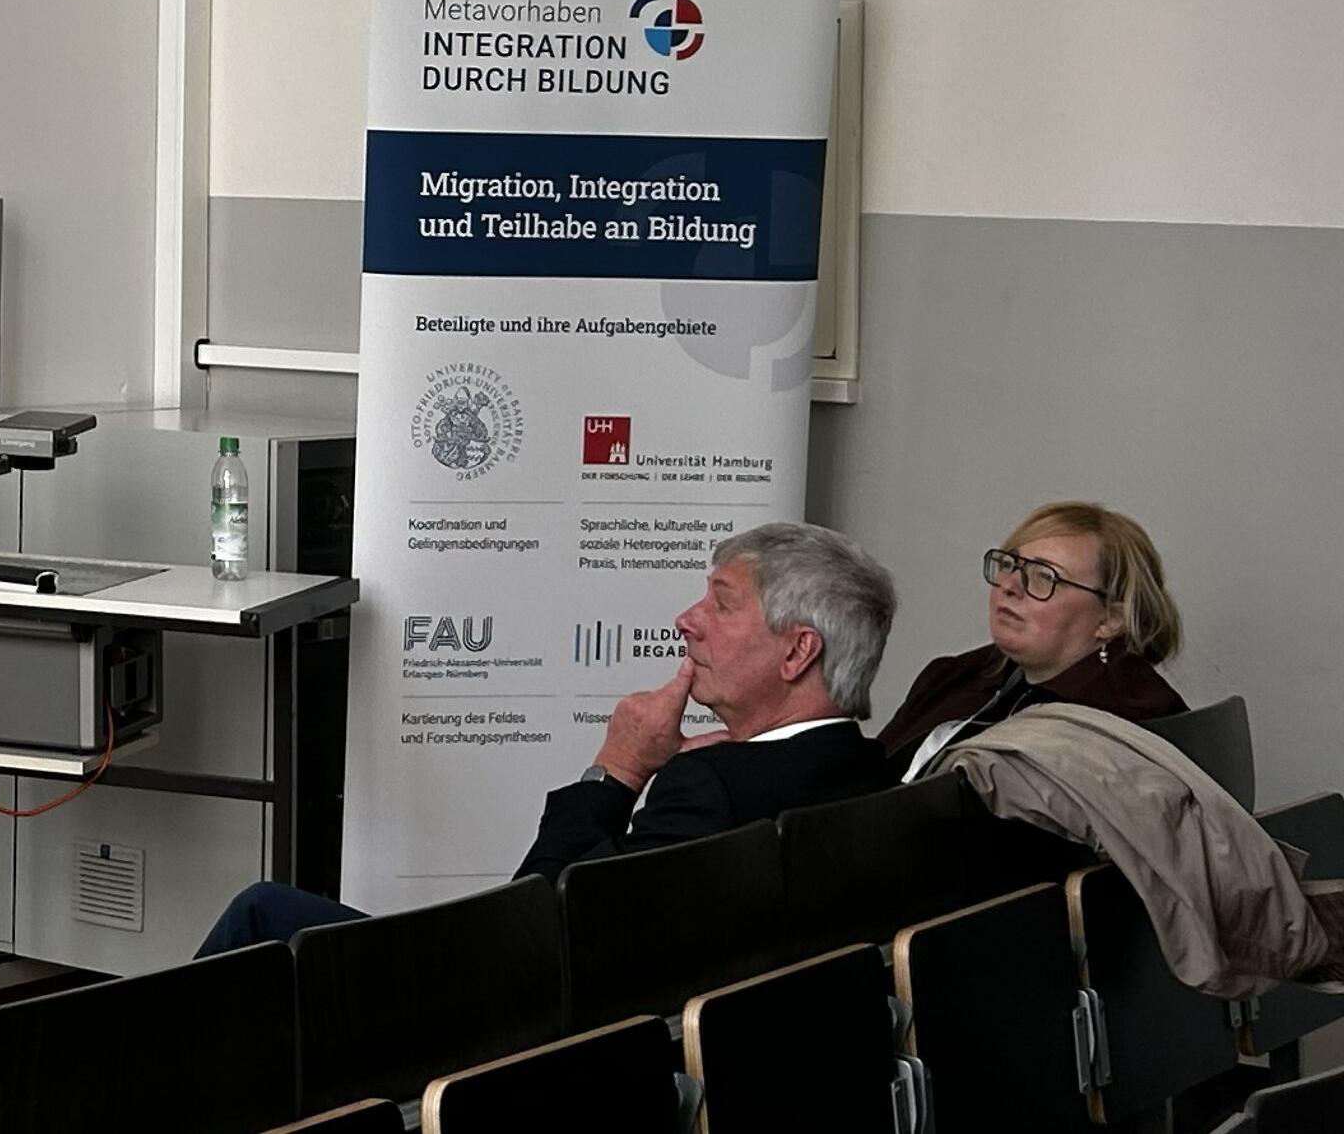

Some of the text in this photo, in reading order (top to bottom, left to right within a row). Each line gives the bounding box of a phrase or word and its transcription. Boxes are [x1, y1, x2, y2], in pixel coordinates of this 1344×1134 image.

[423, 31, 627, 60] INTEGRATION
[422, 66, 670, 95] DURCH BILDUNG
[420, 172, 720, 207] Migration, Integration
[419, 212, 757, 249] und Teilhabe an Bildung
[415, 316, 717, 337] Beteiligte und ihre Aufgabengebiete
[636, 454, 773, 470] Universität Hamburg
[409, 518, 508, 533] Koordination und
[580, 518, 733, 534] Sprachliche, kulturelle und
[408, 538, 539, 553] Gelingensbedingungen
[580, 539, 620, 551] soziale
[621, 557, 707, 571] Internationales
[404, 616, 493, 652] FAU
[402, 712, 526, 727] Kartierung des Feldes
[401, 731, 551, 746] und Forschungssynthesen
